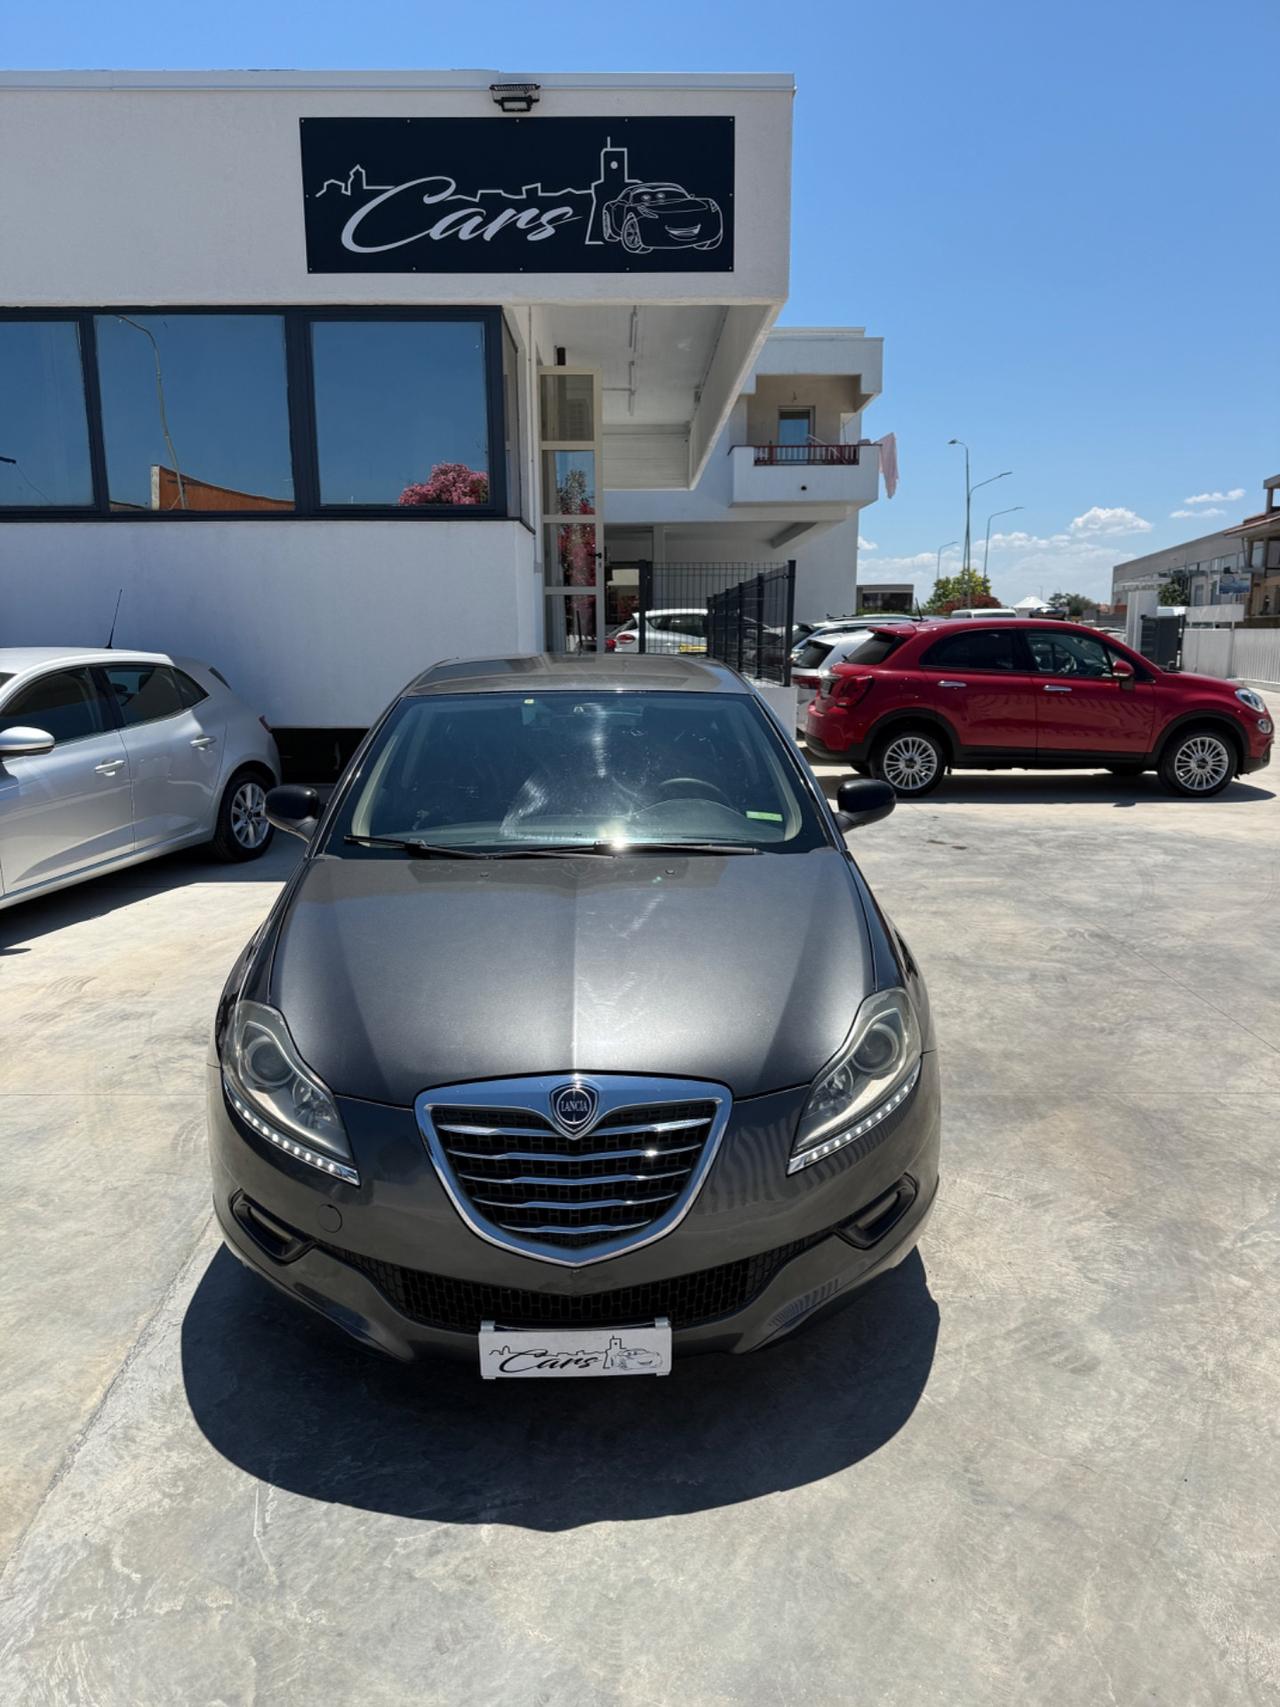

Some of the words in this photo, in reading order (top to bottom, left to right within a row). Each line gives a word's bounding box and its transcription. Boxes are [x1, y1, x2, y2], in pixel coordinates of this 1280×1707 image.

[341, 176, 583, 253] Cars
[561, 1100, 588, 1112] LANCIA
[500, 1349, 602, 1373] Cars
